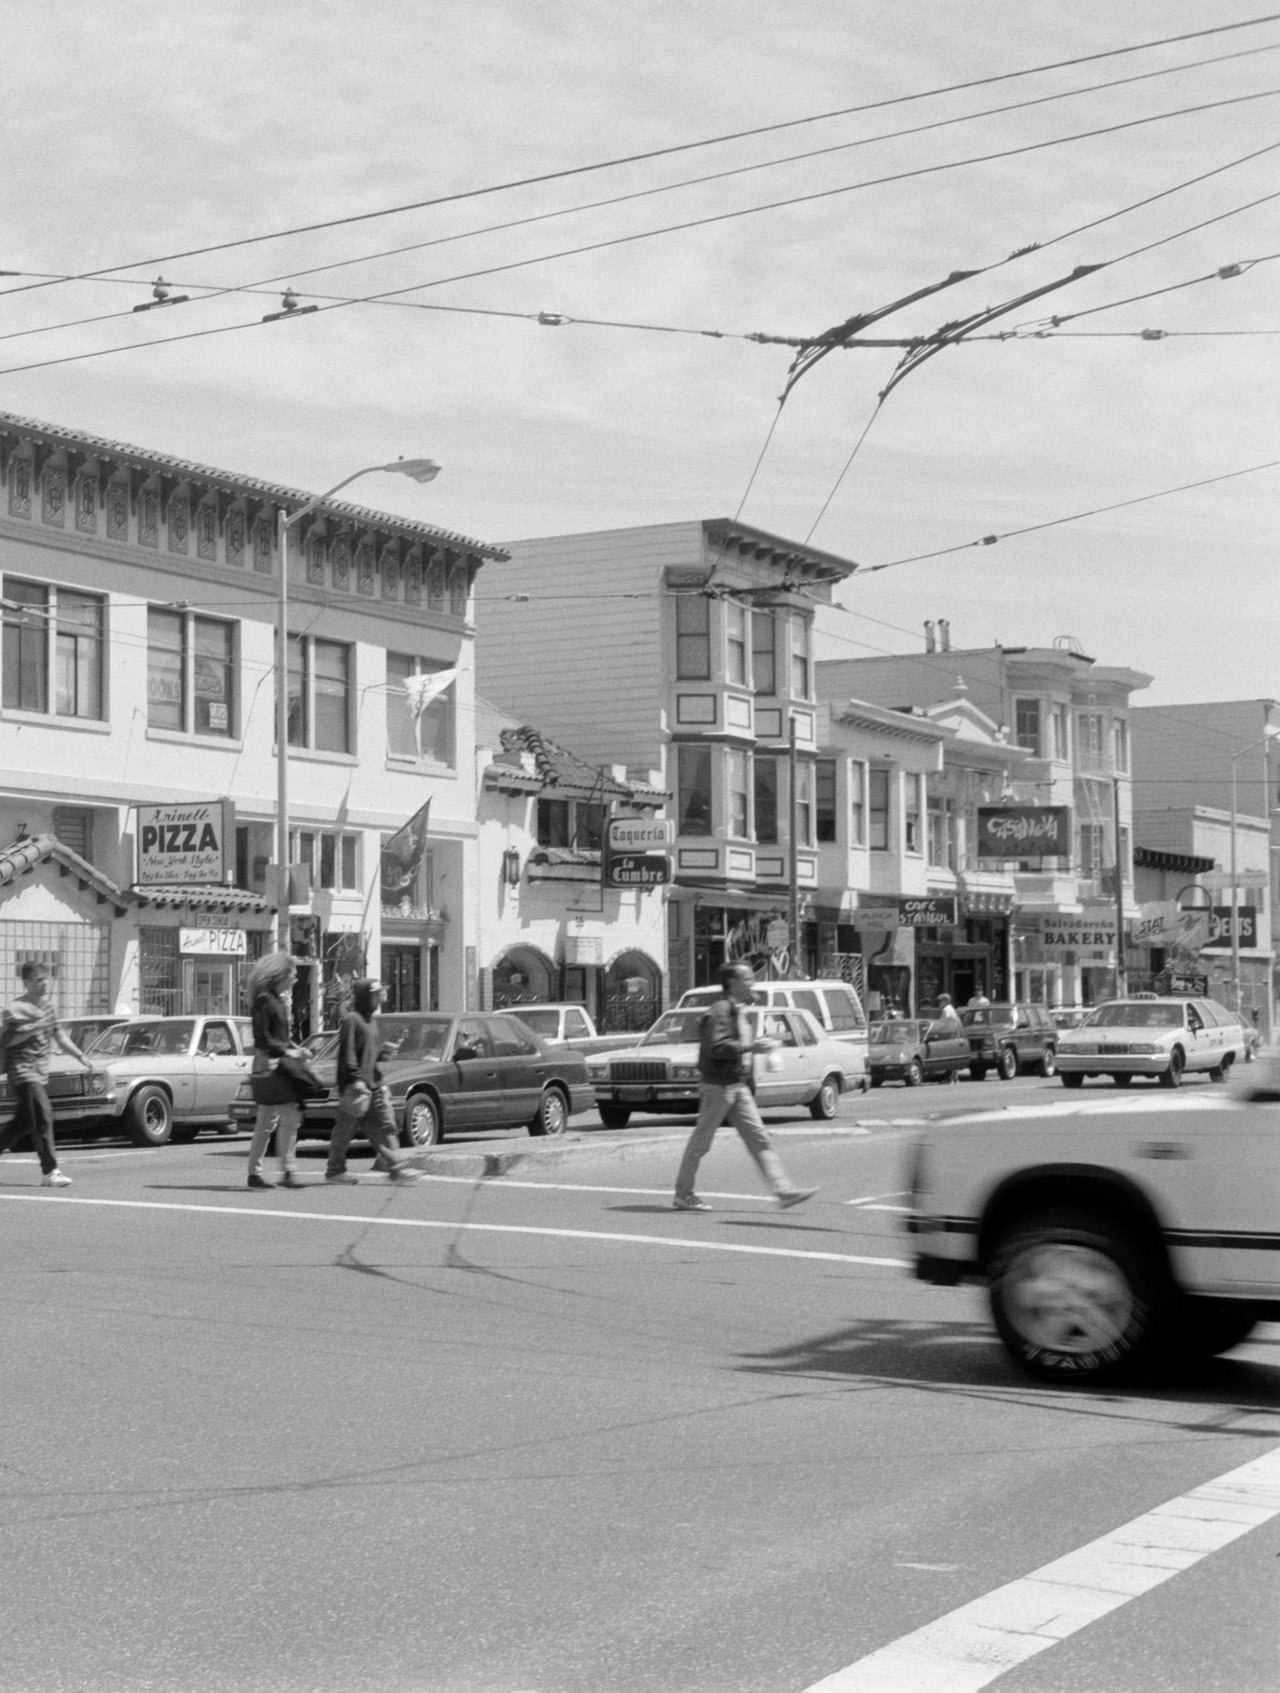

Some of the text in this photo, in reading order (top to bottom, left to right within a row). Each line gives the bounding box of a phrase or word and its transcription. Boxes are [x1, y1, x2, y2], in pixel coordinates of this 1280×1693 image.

[986, 815, 1058, 840] CASANOVA
[142, 823, 219, 854] PIZZA
[622, 858, 634, 868] La
[612, 866, 665, 882] Cumbre
[209, 930, 244, 951] PIZZA
[1044, 932, 1116, 945] BAKERY
